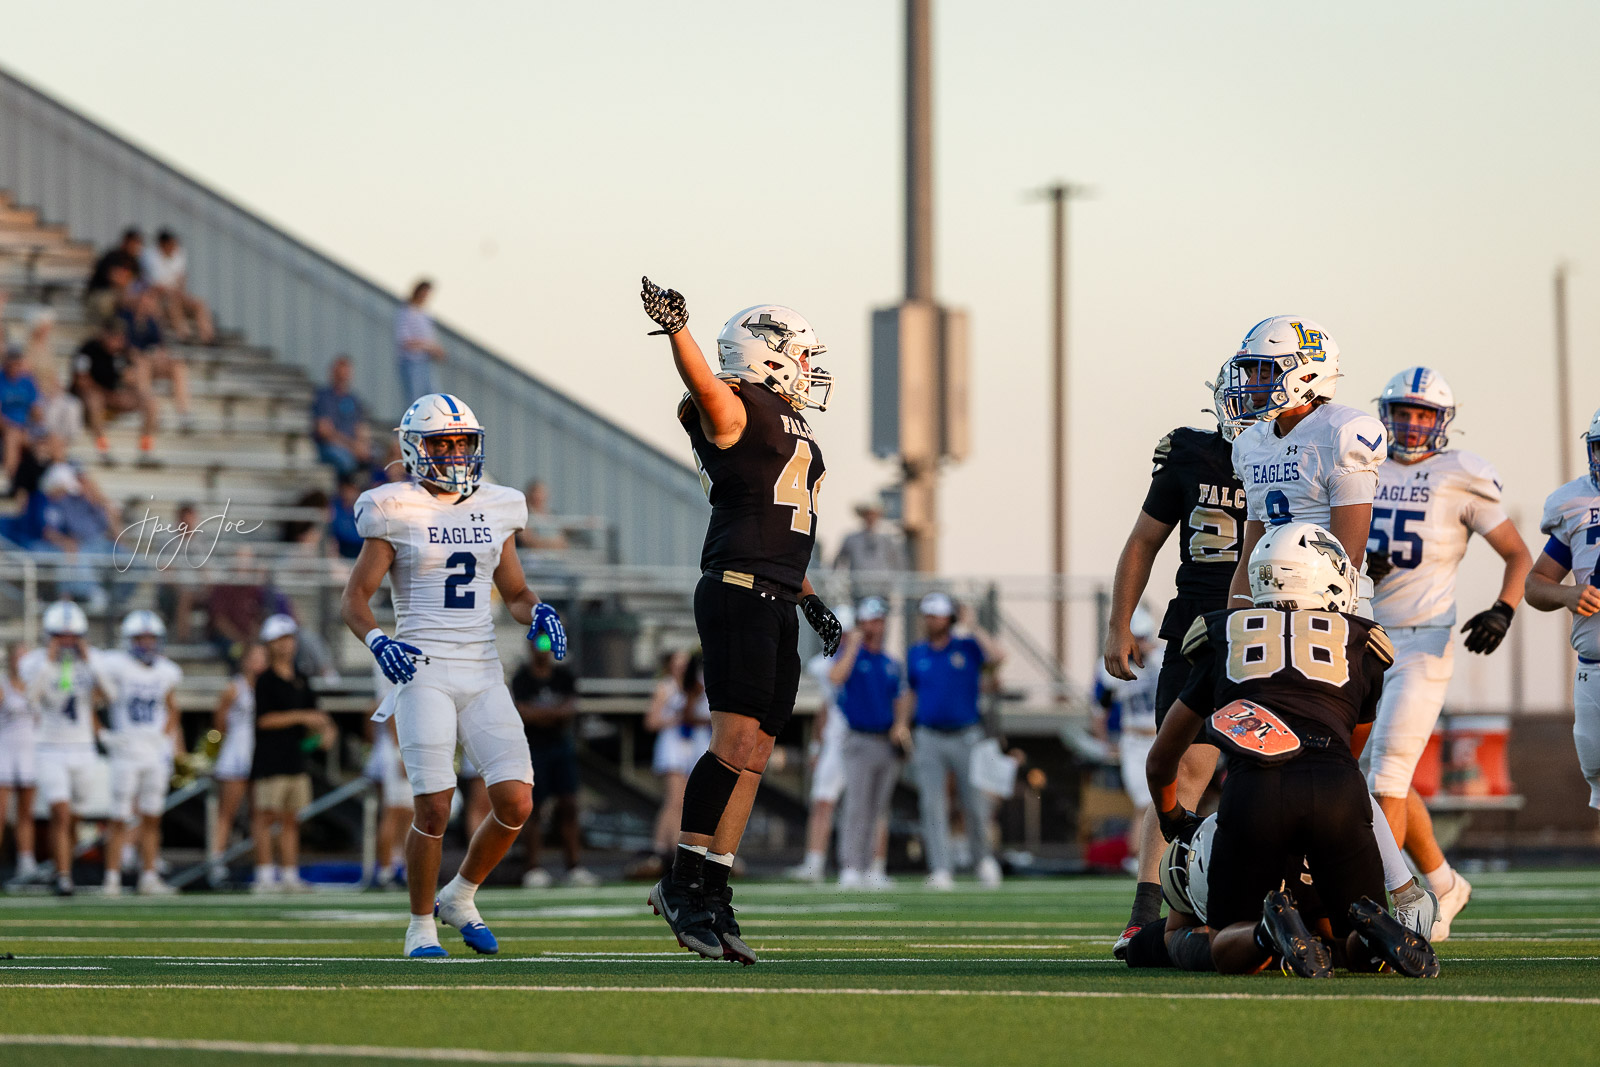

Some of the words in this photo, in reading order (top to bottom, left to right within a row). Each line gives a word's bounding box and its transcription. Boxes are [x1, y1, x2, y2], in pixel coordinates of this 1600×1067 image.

[1253, 462, 1300, 484] EAGLES
[428, 526, 493, 544] EAGLES
[1366, 507, 1426, 570] 55
[443, 551, 477, 609] 2
[1259, 564, 1273, 581] 88
[1226, 608, 1350, 688] 88
